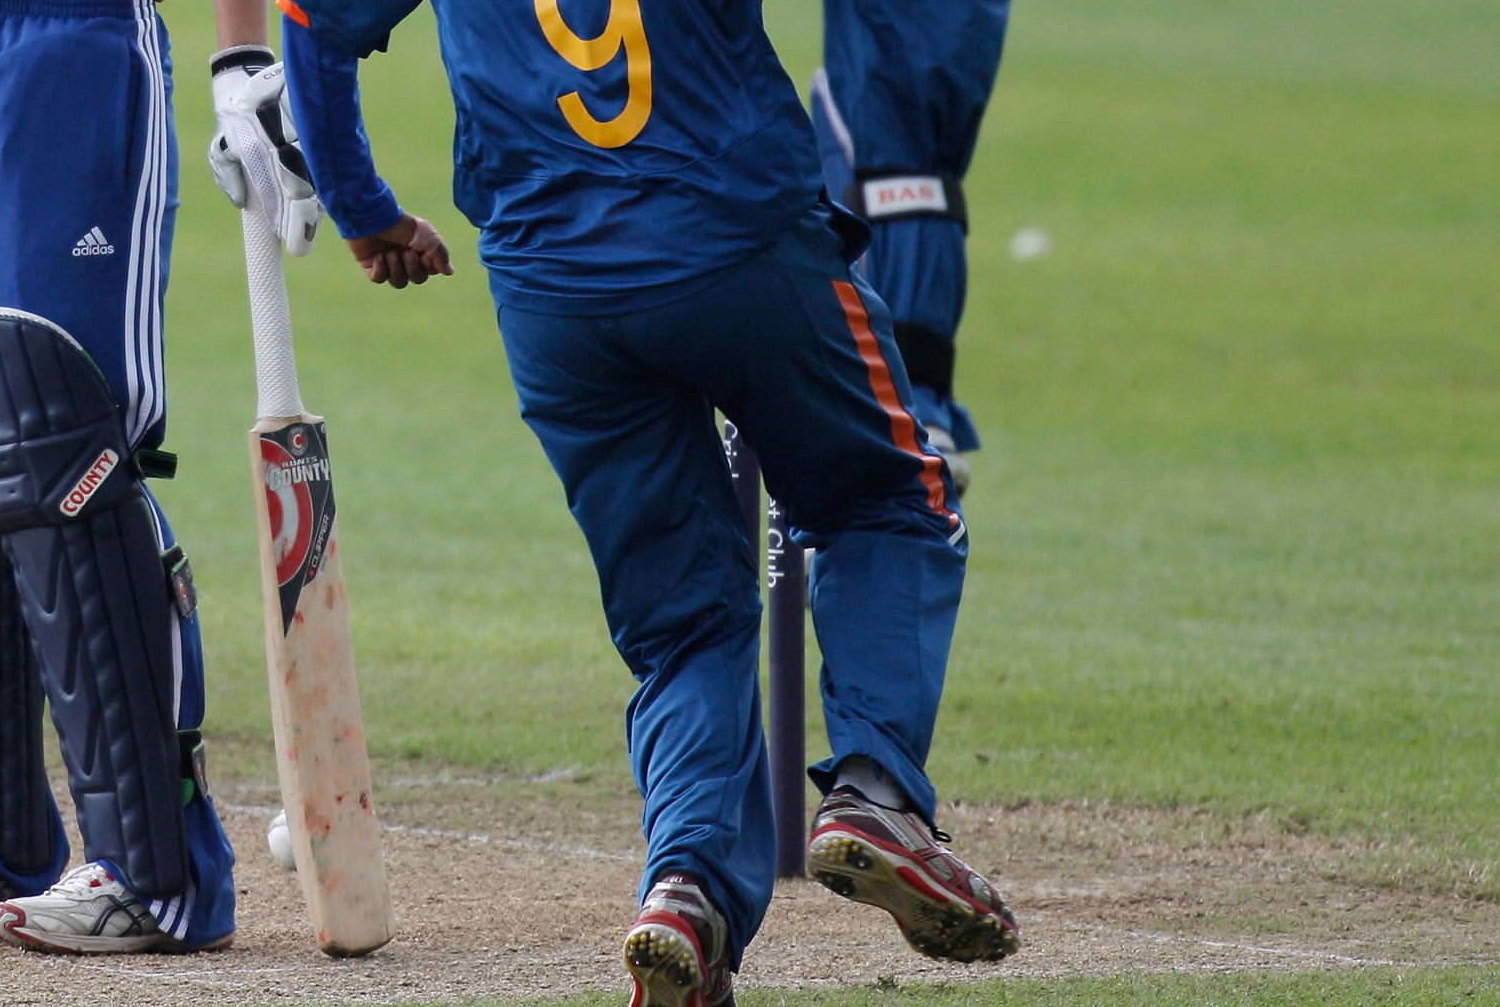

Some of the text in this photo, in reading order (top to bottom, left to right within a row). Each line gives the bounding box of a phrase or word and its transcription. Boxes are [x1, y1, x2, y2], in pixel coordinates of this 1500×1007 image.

[263, 67, 283, 80] CLIP
[878, 184, 935, 205] BAS
[72, 244, 114, 257] adidas
[282, 455, 318, 468] HUNTS
[63, 451, 114, 512] COUNTY
[267, 458, 330, 491] COUNTY
[311, 514, 330, 568] CLIPPER
